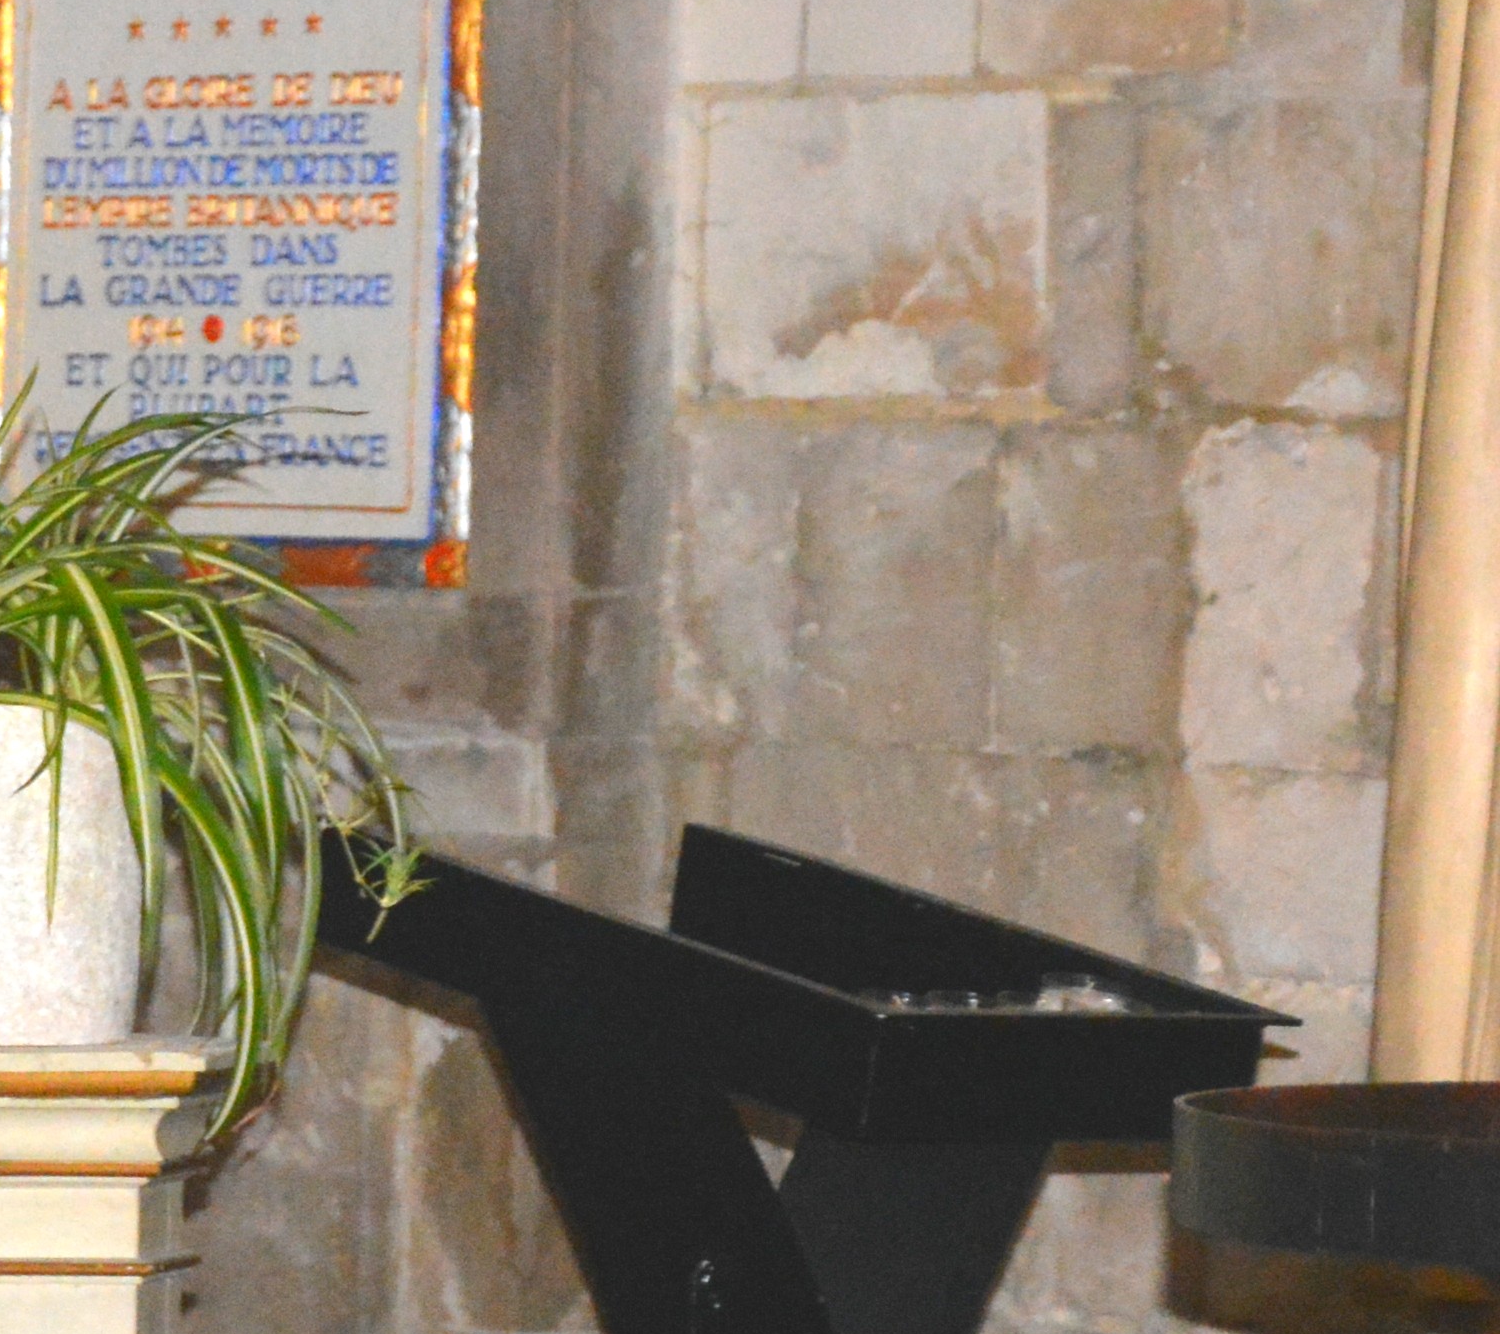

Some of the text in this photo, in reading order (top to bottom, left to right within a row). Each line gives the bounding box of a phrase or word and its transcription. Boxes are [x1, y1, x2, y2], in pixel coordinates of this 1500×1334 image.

[48, 79, 73, 110] A
[87, 79, 129, 110] LA
[271, 71, 313, 106] DE
[74, 116, 116, 149] ET
[130, 115, 153, 147] A
[166, 115, 210, 147] LA
[209, 155, 247, 187] DE
[361, 152, 398, 185] DE
[250, 233, 340, 266] DANS
[39, 273, 394, 307] LA GRANDE GUERRE
[65, 355, 110, 387] ET
[203, 353, 292, 386] POUR
[310, 355, 360, 387] LA
[260, 433, 389, 468] FRANCE
